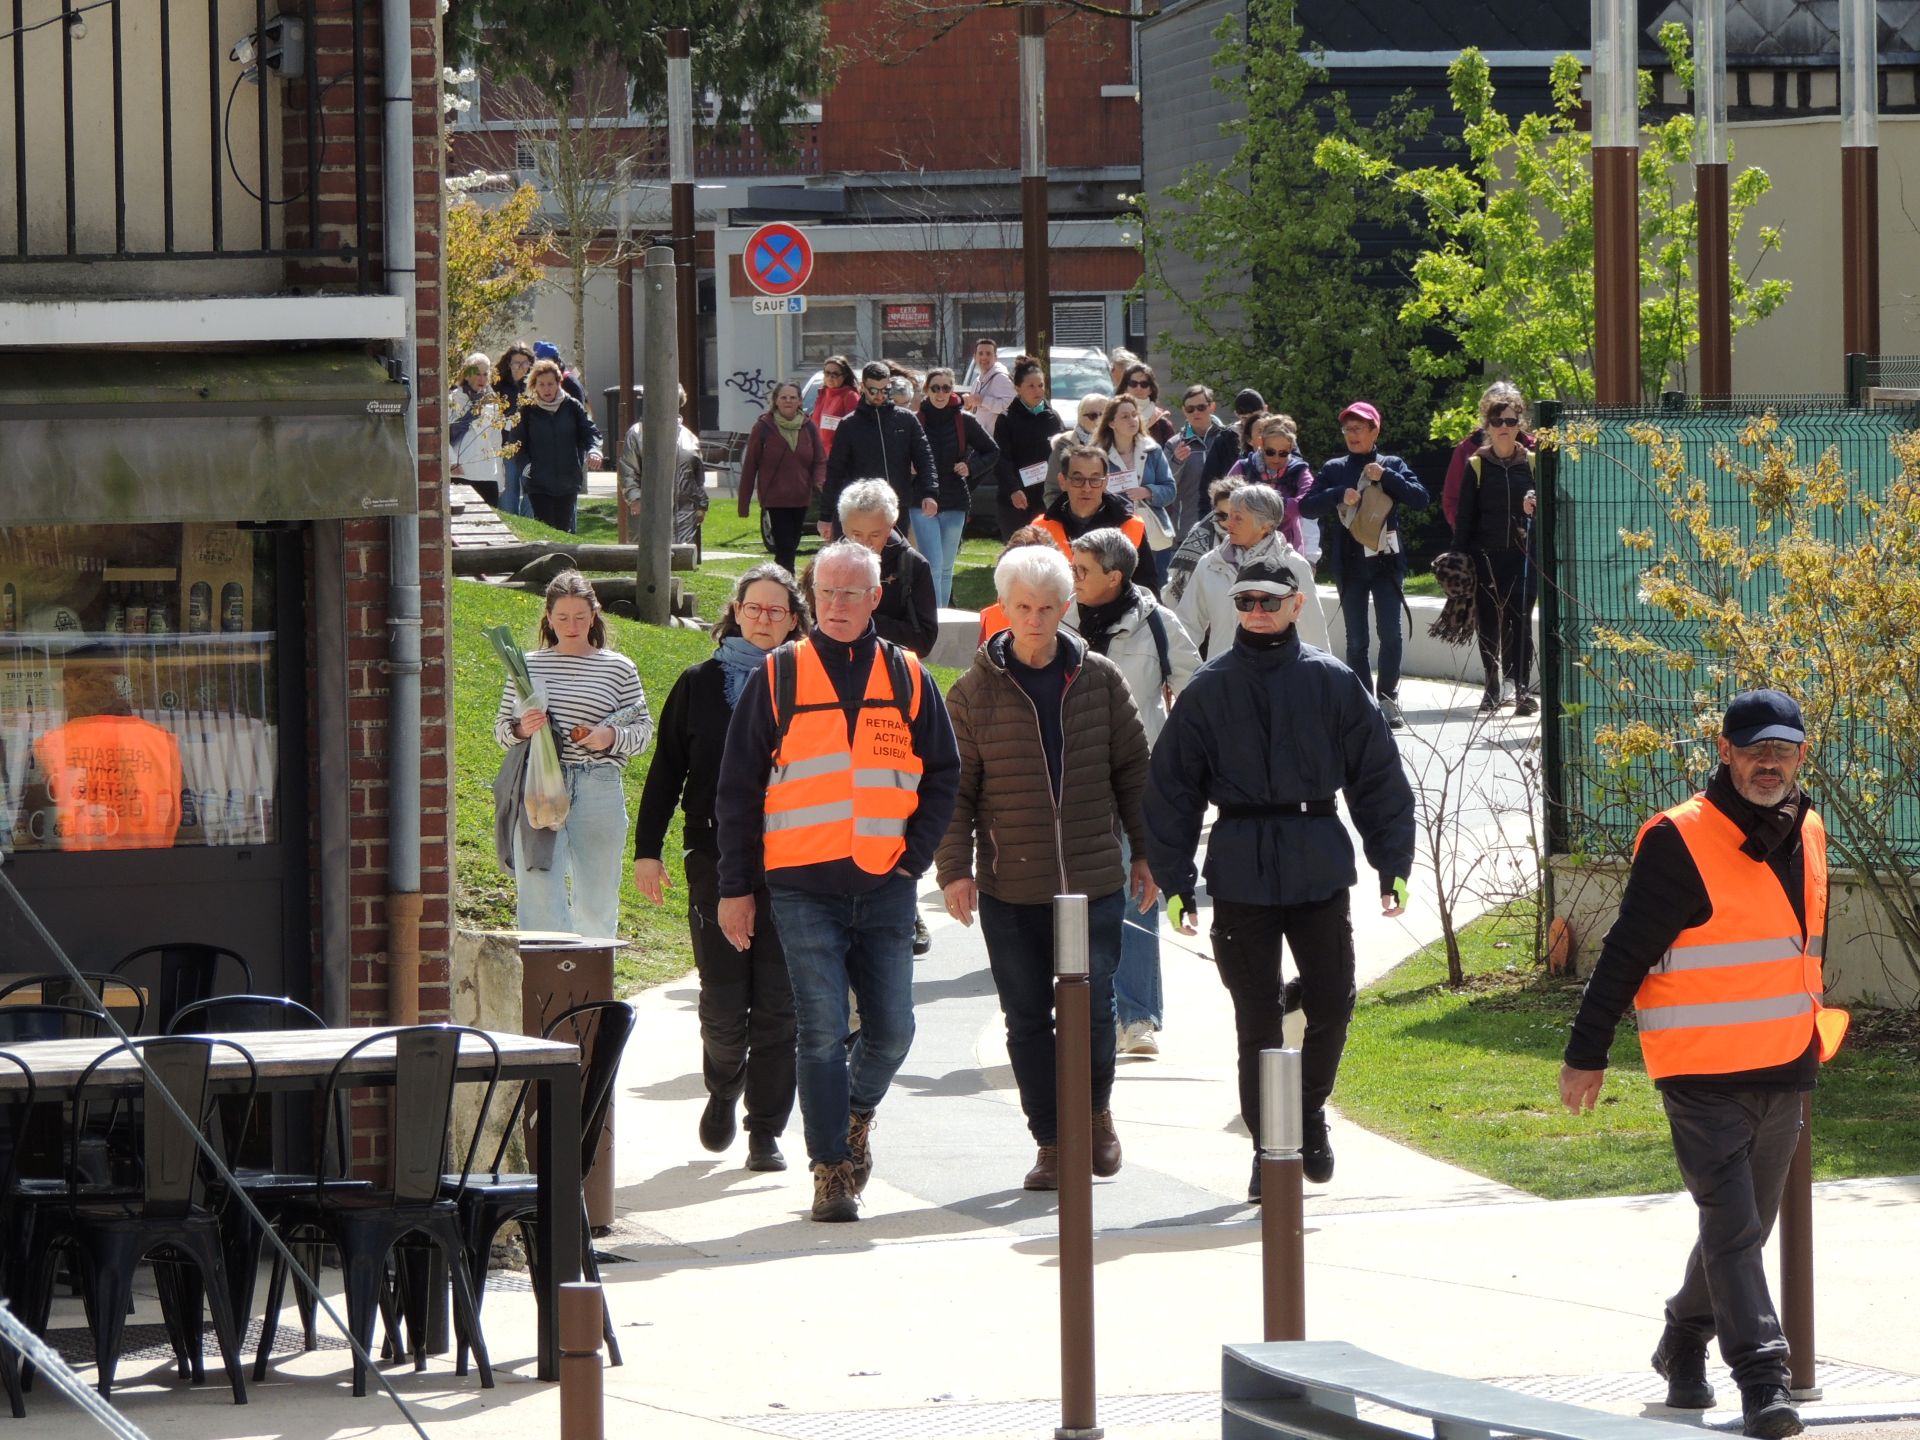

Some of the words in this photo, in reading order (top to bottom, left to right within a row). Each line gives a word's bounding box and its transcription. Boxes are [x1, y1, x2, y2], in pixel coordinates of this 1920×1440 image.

[754, 300, 785, 312] SAUF
[874, 732, 908, 746] ACTIVE
[873, 746, 907, 760] LISIEUX
